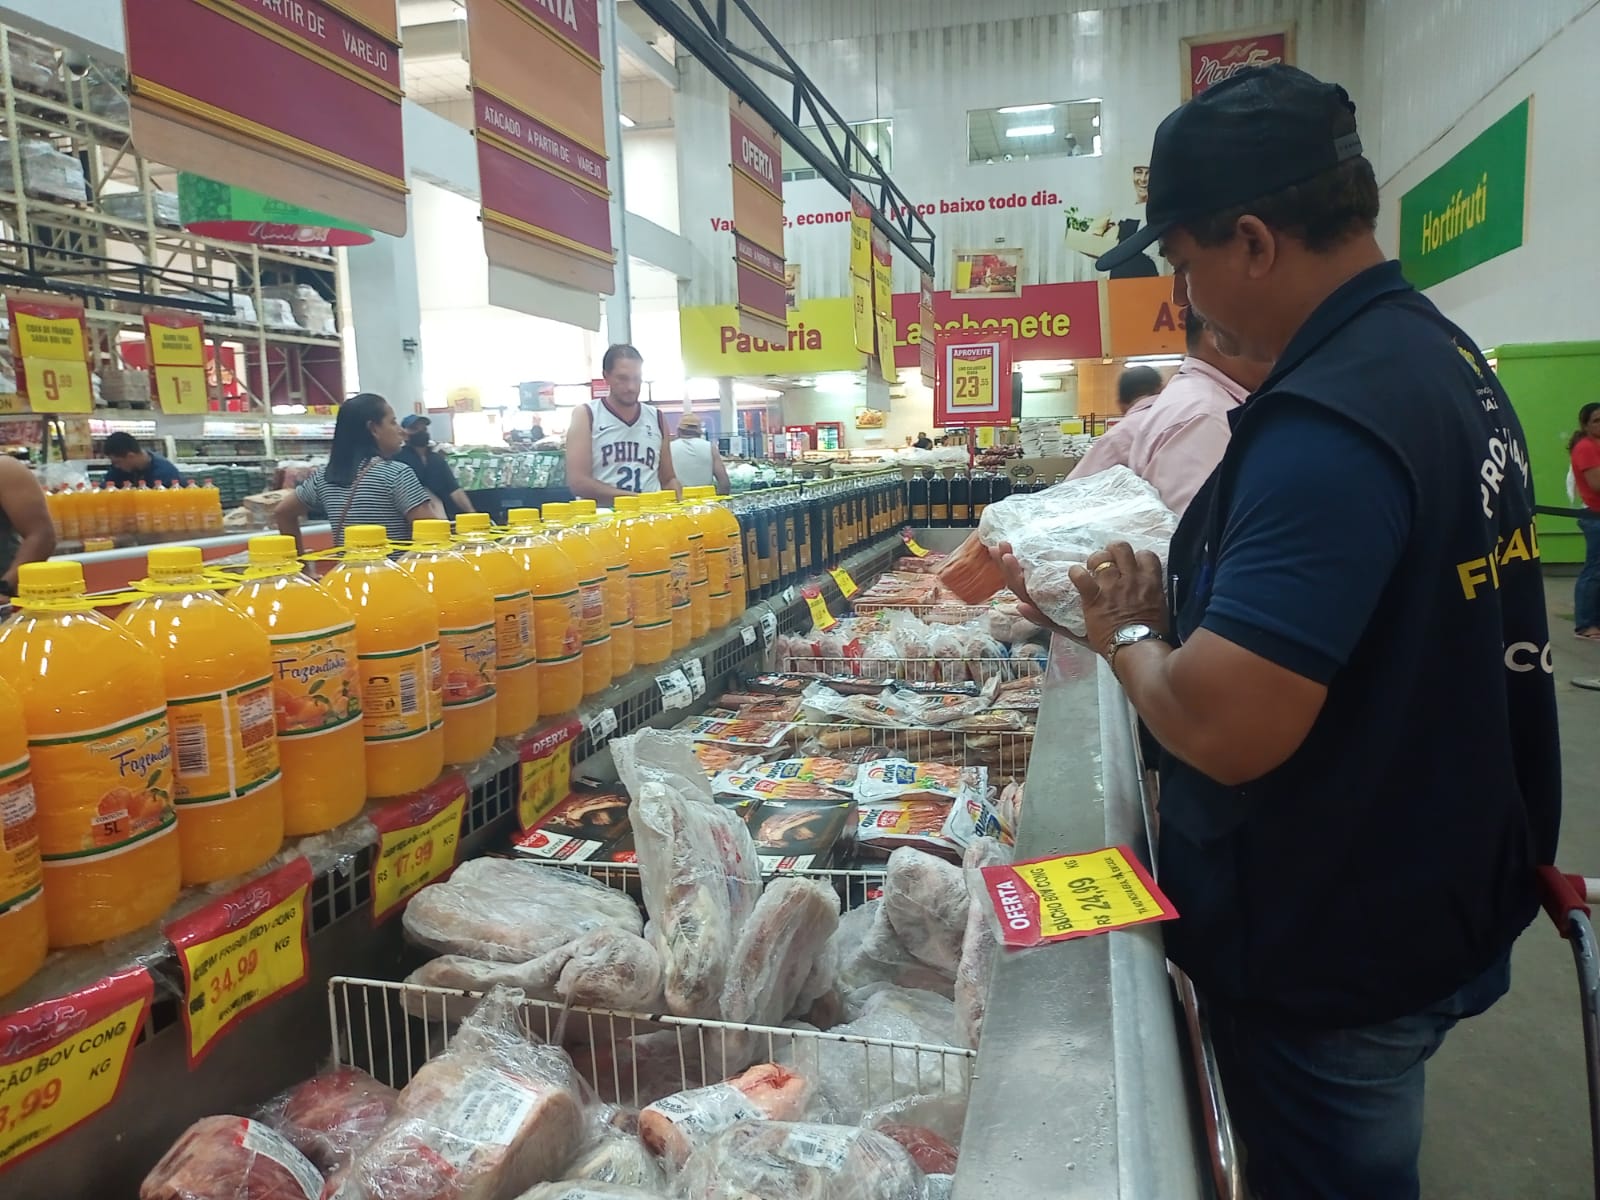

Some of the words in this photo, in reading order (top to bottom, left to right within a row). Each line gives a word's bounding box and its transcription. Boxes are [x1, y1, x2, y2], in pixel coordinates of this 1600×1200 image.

[307, 10, 326, 39] DE
[343, 29, 388, 71] VAREJO
[484, 106, 521, 138] ATACADO
[527, 128, 534, 145] A
[533, 131, 560, 158] PARTIR
[560, 144, 571, 163] DE
[577, 153, 601, 179] VAREJO
[741, 135, 775, 184] OFERTA
[939, 197, 985, 214] baixo
[989, 193, 1027, 210] todo
[1031, 190, 1063, 207] dia.
[1421, 171, 1488, 256] Hortifruti
[953, 347, 992, 357] APROVEITE
[601, 441, 656, 470] PHILA
[616, 466, 642, 493] 21
[532, 727, 569, 756] OFERTA
[104, 820, 122, 837] 5L
[1064, 858, 1080, 869] KG
[1030, 868, 1050, 889] CONG
[995, 879, 1031, 931] OFERTA
[1039, 886, 1055, 902] BOV
[1068, 876, 1113, 912] 24,99
[1046, 898, 1074, 931] BUCHO
[1094, 914, 1113, 926] R$
[274, 936, 291, 952] KG
[35, 1045, 75, 1075] BOV
[79, 1021, 127, 1054] CONG
[88, 1057, 112, 1081] KG
